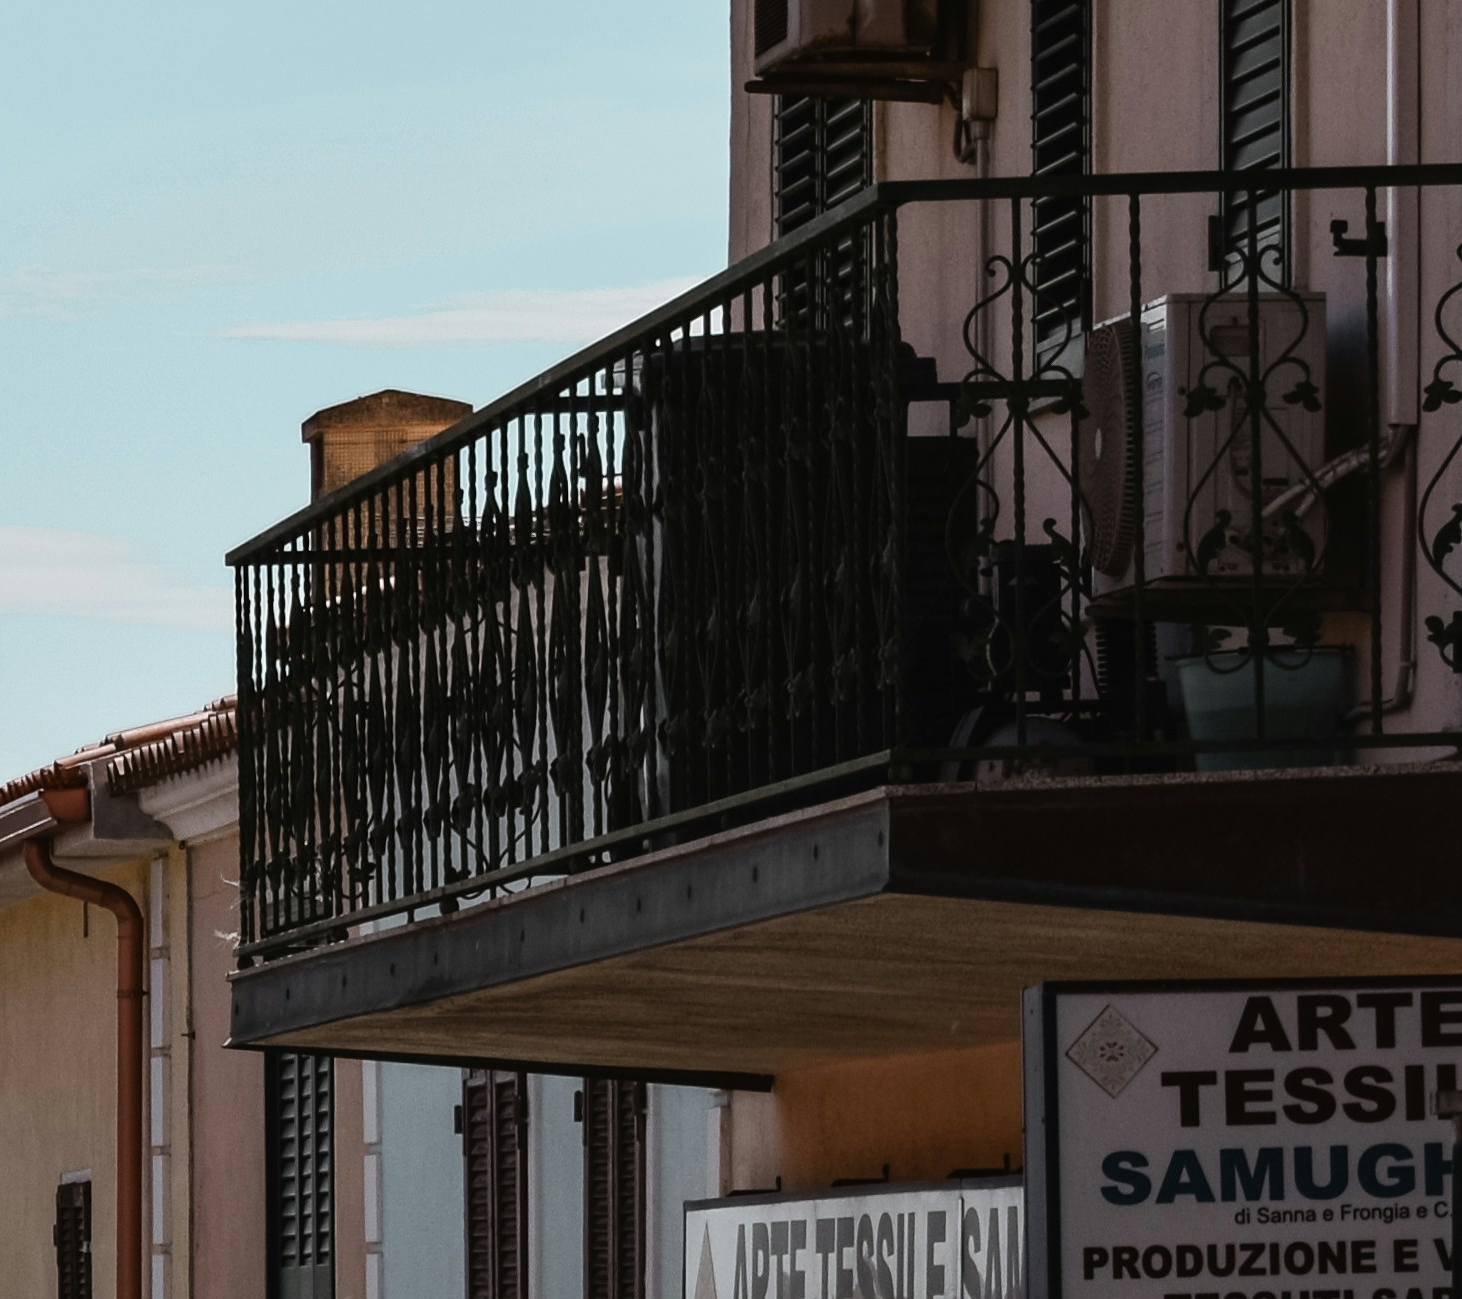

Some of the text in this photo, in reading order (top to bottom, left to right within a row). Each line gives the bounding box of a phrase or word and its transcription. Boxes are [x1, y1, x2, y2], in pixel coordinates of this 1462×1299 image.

[1228, 990, 1462, 1053] ARTE
[1161, 1064, 1462, 1128] TESSIL
[1100, 1142, 1453, 1206] SAMUGH
[1234, 1206, 1250, 1225] di
[1257, 1206, 1316, 1224] Sanna
[1323, 1208, 1334, 1222] e
[1340, 1202, 1410, 1224] Frongia
[1416, 1205, 1428, 1219] e
[1083, 1239, 1377, 1281] PRODUZIONE
[1394, 1239, 1419, 1274] E
